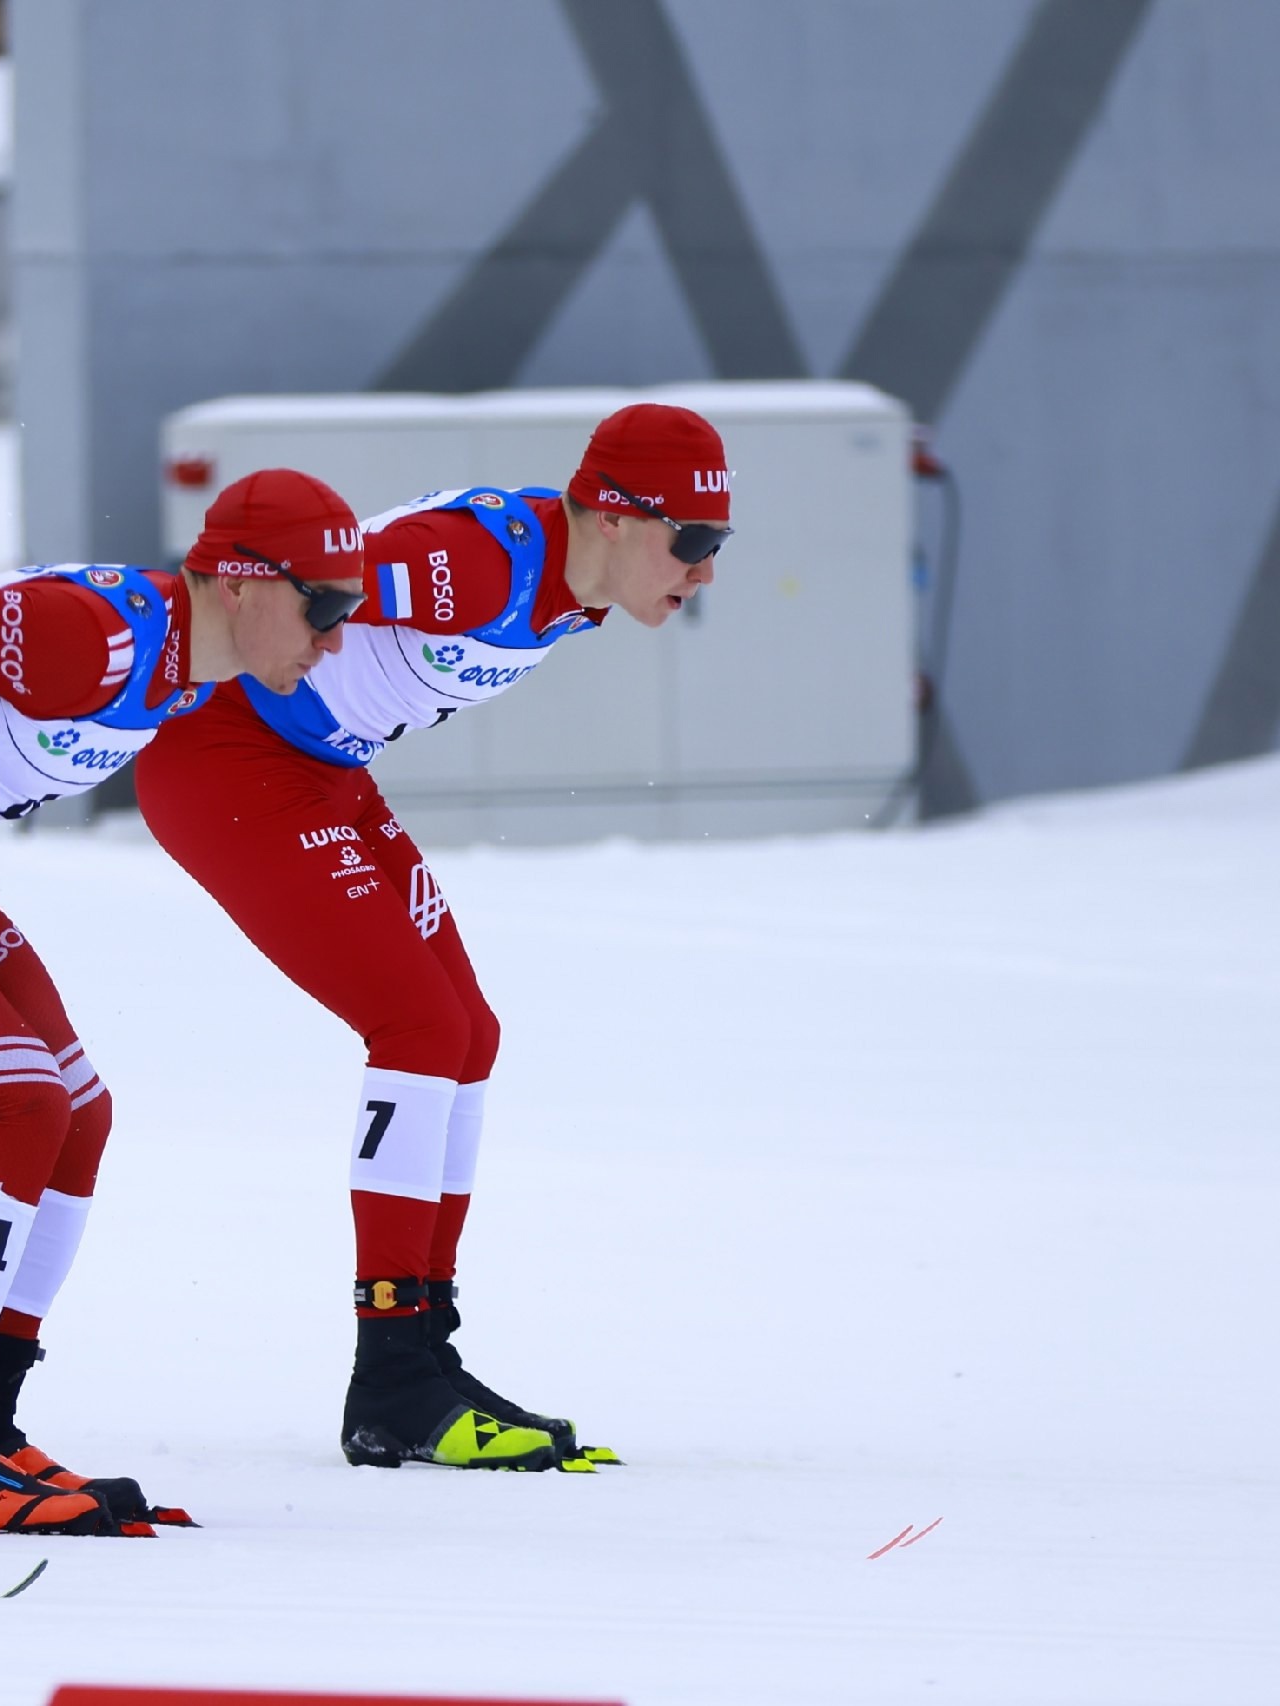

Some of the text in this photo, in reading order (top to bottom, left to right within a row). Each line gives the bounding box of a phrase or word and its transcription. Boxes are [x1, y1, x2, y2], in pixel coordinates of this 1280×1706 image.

[428, 550, 454, 621] BOSCO
[1, 590, 23, 684] BOSCO
[358, 1100, 397, 1160] 7
